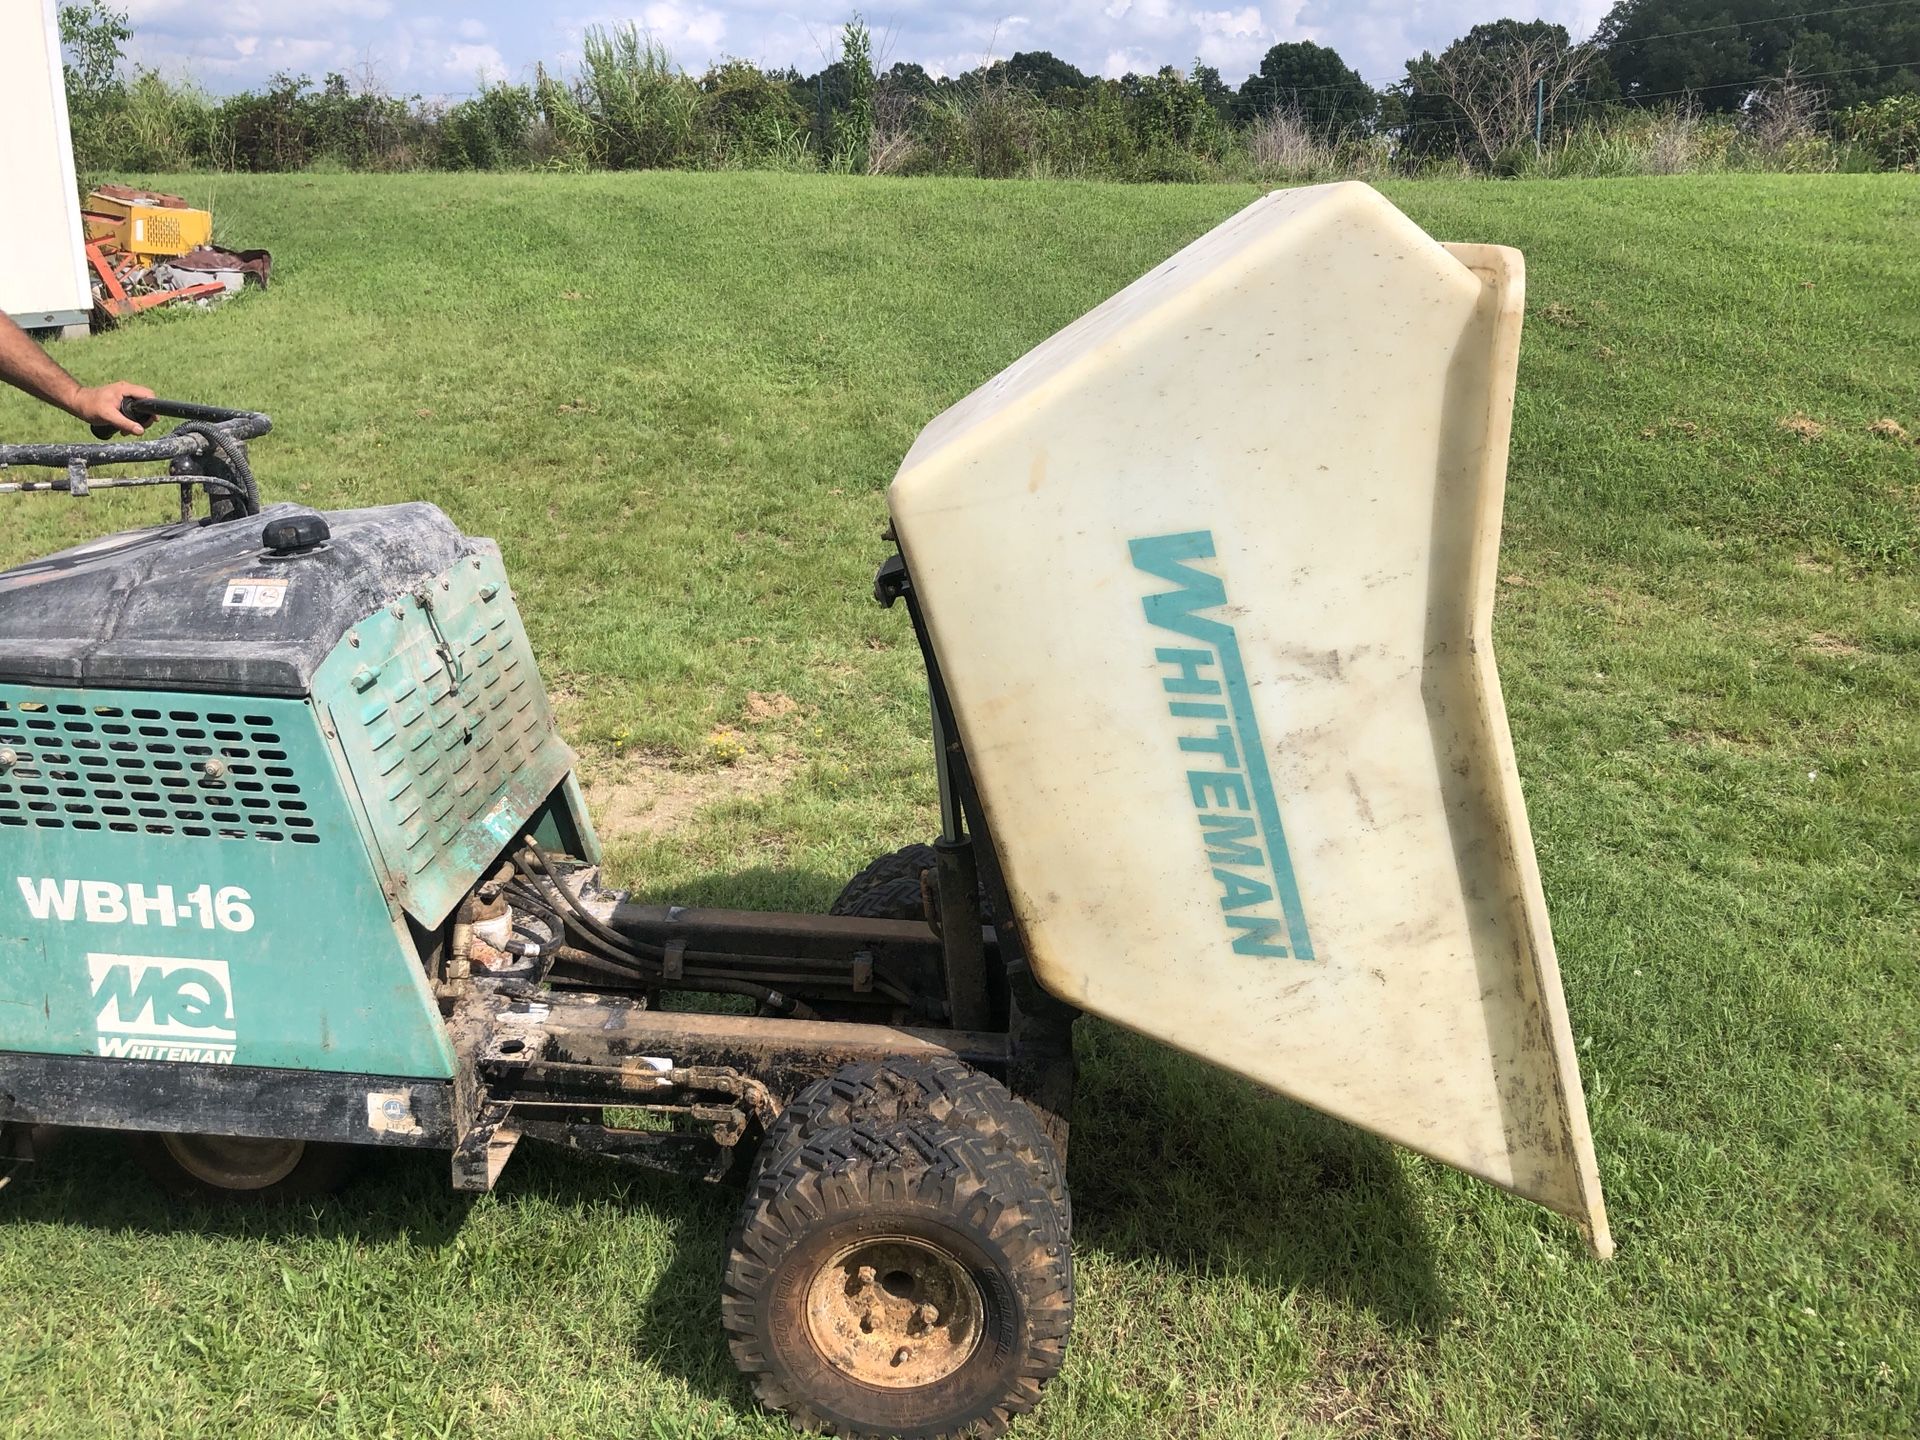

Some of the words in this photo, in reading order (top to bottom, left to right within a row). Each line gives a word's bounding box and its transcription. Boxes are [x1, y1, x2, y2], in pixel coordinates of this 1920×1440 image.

[1128, 530, 1315, 961] WHITEMAN
[17, 876, 255, 932] WBH-16
[91, 961, 237, 1032] MQ
[98, 1036, 237, 1065] WHITEMAN
